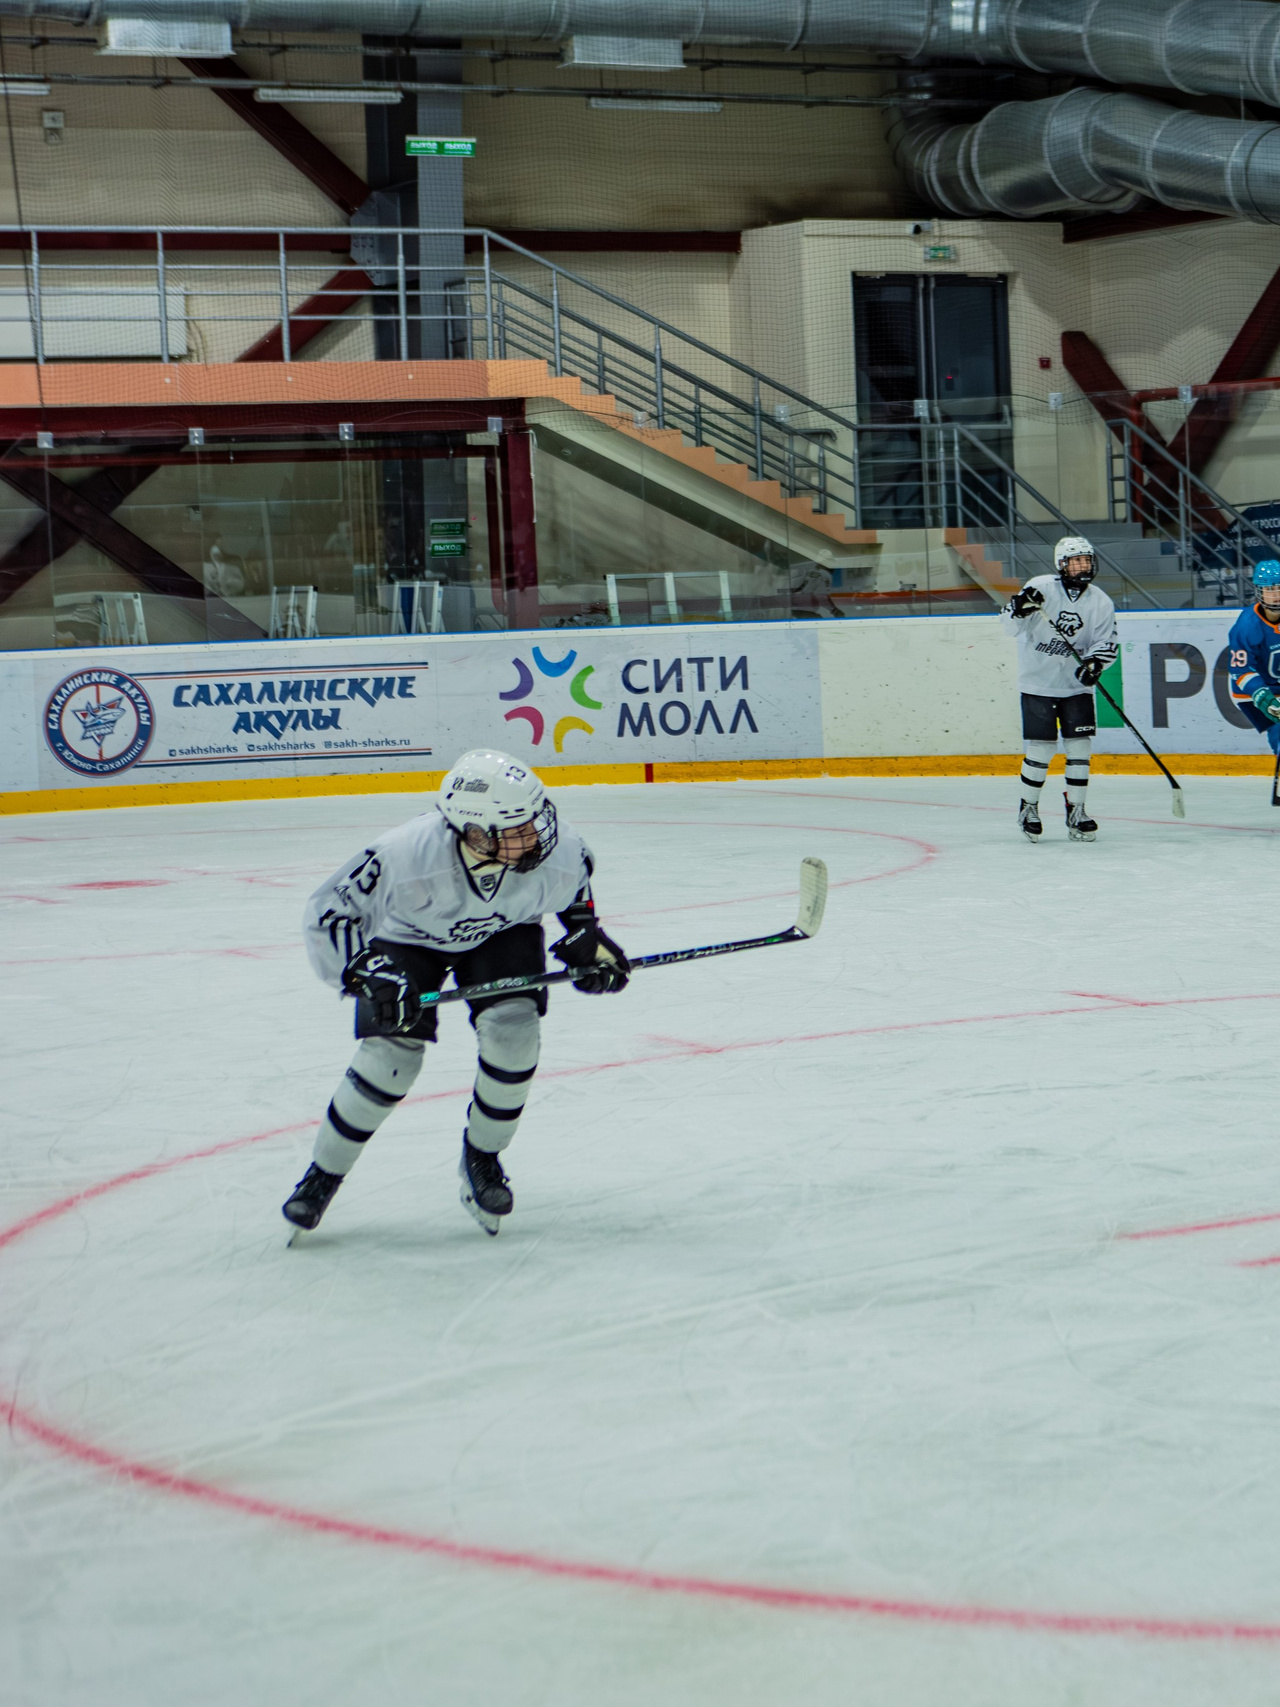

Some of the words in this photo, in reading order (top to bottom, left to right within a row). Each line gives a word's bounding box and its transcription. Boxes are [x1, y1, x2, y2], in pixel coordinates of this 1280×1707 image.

[621, 656, 749, 694] СИТИ
[1230, 649, 1248, 668] 29
[173, 676, 416, 708] САХАЛИНСКИЕ
[231, 707, 343, 741] АКУЛЫ
[617, 699, 759, 737] МОЛЛ
[178, 744, 238, 756] sakhsharks
[256, 741, 316, 752] sakhsharks
[333, 737, 411, 749] sakh-sharks.ru
[348, 848, 381, 896] 13
